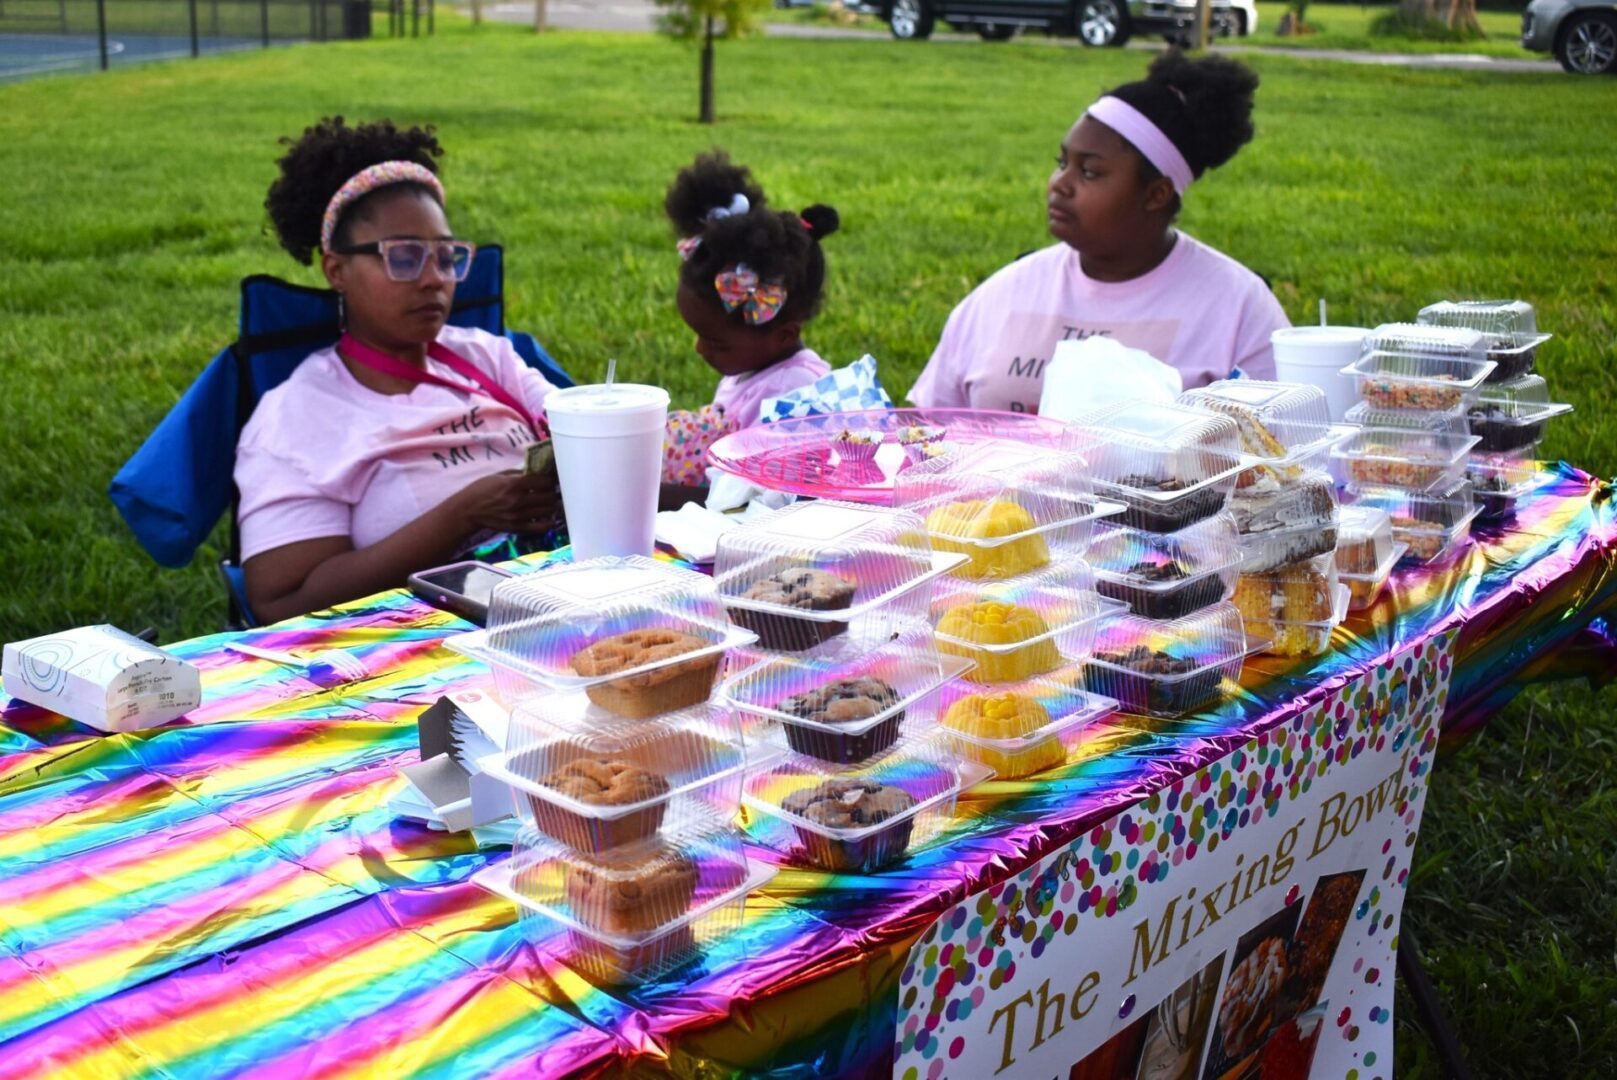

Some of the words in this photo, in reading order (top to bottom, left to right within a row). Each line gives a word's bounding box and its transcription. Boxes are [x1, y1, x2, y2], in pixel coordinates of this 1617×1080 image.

[1062, 325, 1112, 342] TH
[433, 406, 485, 436] THE
[987, 969, 1100, 1076] The
[1121, 816, 1305, 989] Mixing
[1306, 747, 1410, 862] Bowl
